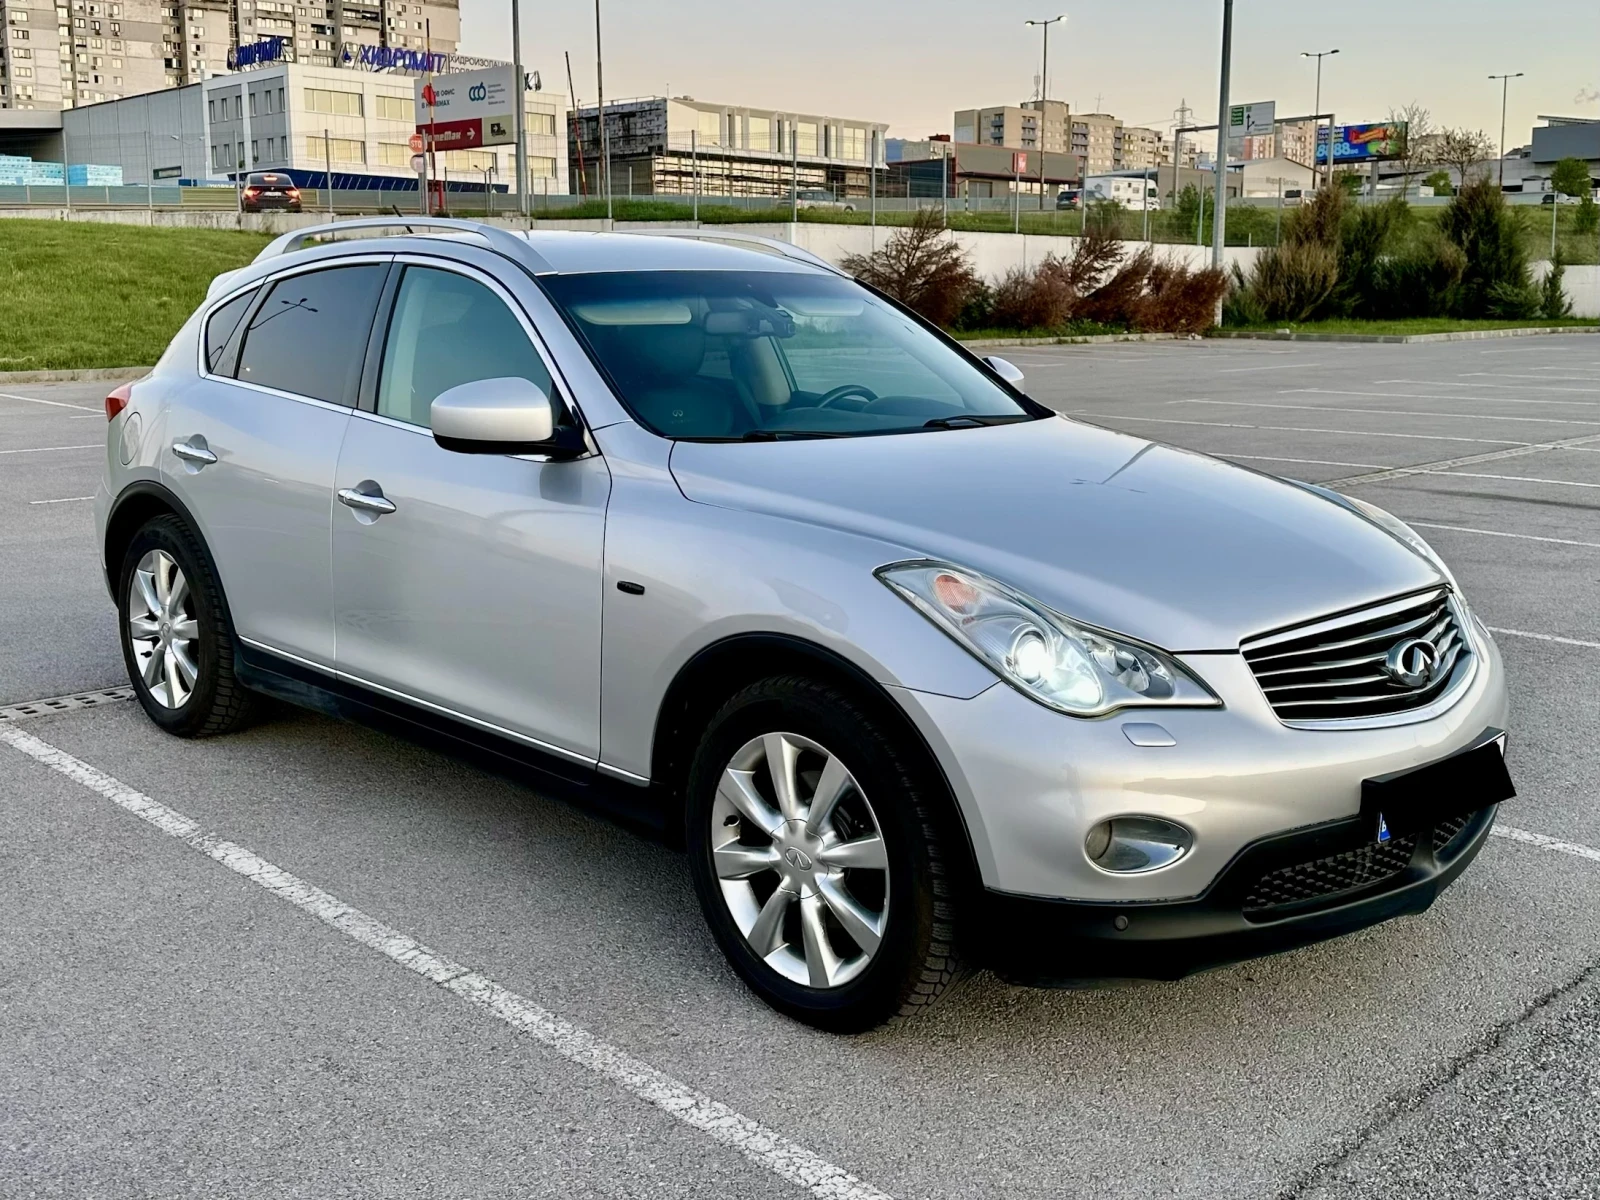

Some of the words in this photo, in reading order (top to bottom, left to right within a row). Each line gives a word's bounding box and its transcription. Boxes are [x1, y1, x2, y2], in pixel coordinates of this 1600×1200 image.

[360, 44, 446, 73] ХИДРОМАТ
[441, 88, 455, 97] ОФИС
[410, 139, 422, 149] STO
